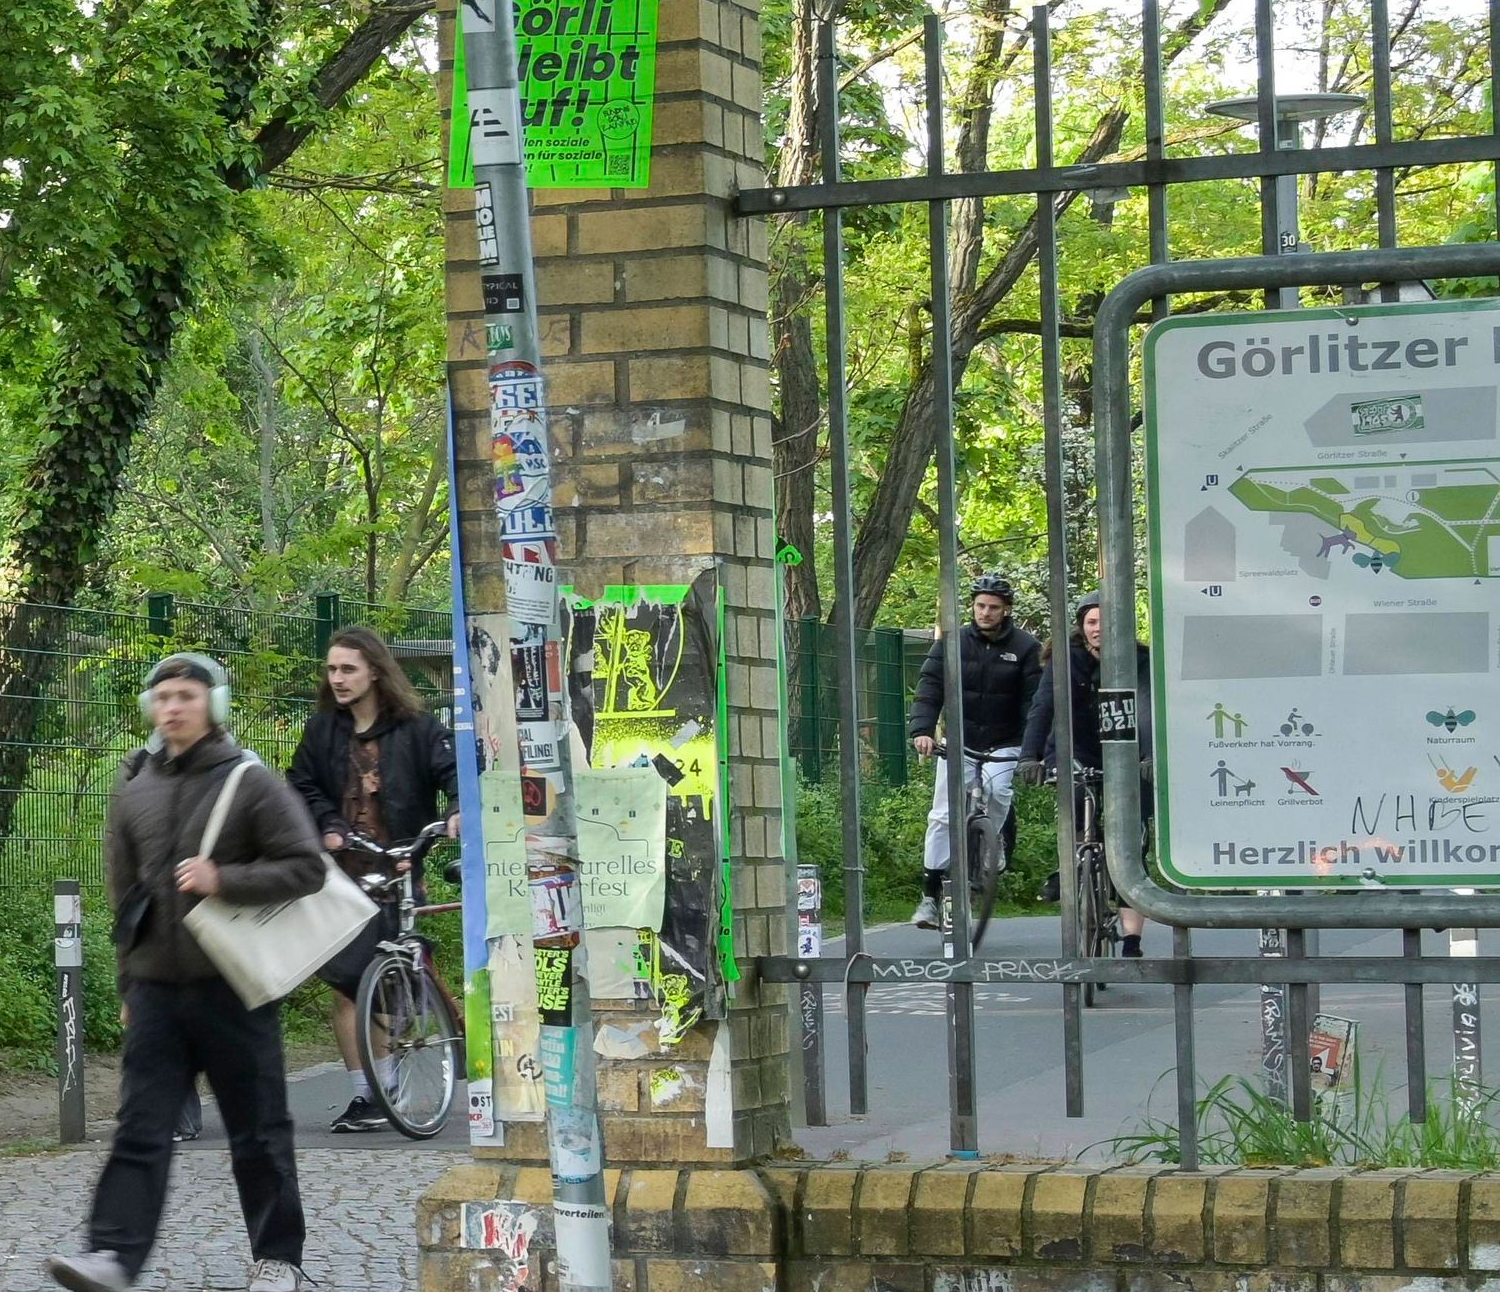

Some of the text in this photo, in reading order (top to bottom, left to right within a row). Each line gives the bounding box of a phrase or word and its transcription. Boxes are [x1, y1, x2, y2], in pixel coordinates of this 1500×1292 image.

[546, 136, 590, 147] soziale
[537, 150, 557, 160] für
[558, 150, 603, 161] soziale
[1281, 234, 1296, 247] 30
[1197, 333, 1469, 379] Görlitzer
[1218, 413, 1274, 460] Skalitzer Straße
[1316, 449, 1389, 460] Görlitzer Straße
[1238, 568, 1298, 578] Spreewaldplatz
[1373, 597, 1438, 608] Wiener Straße
[1099, 699, 1135, 719] ELU
[1099, 715, 1136, 733] OZA
[1208, 739, 1316, 749] Fußverkehr hat Vorrang.
[1426, 736, 1476, 745] Naturraum
[1209, 798, 1266, 808] Leinenpflicht
[1277, 798, 1324, 807] Grillverbot
[1212, 840, 1360, 865] Herzlich
